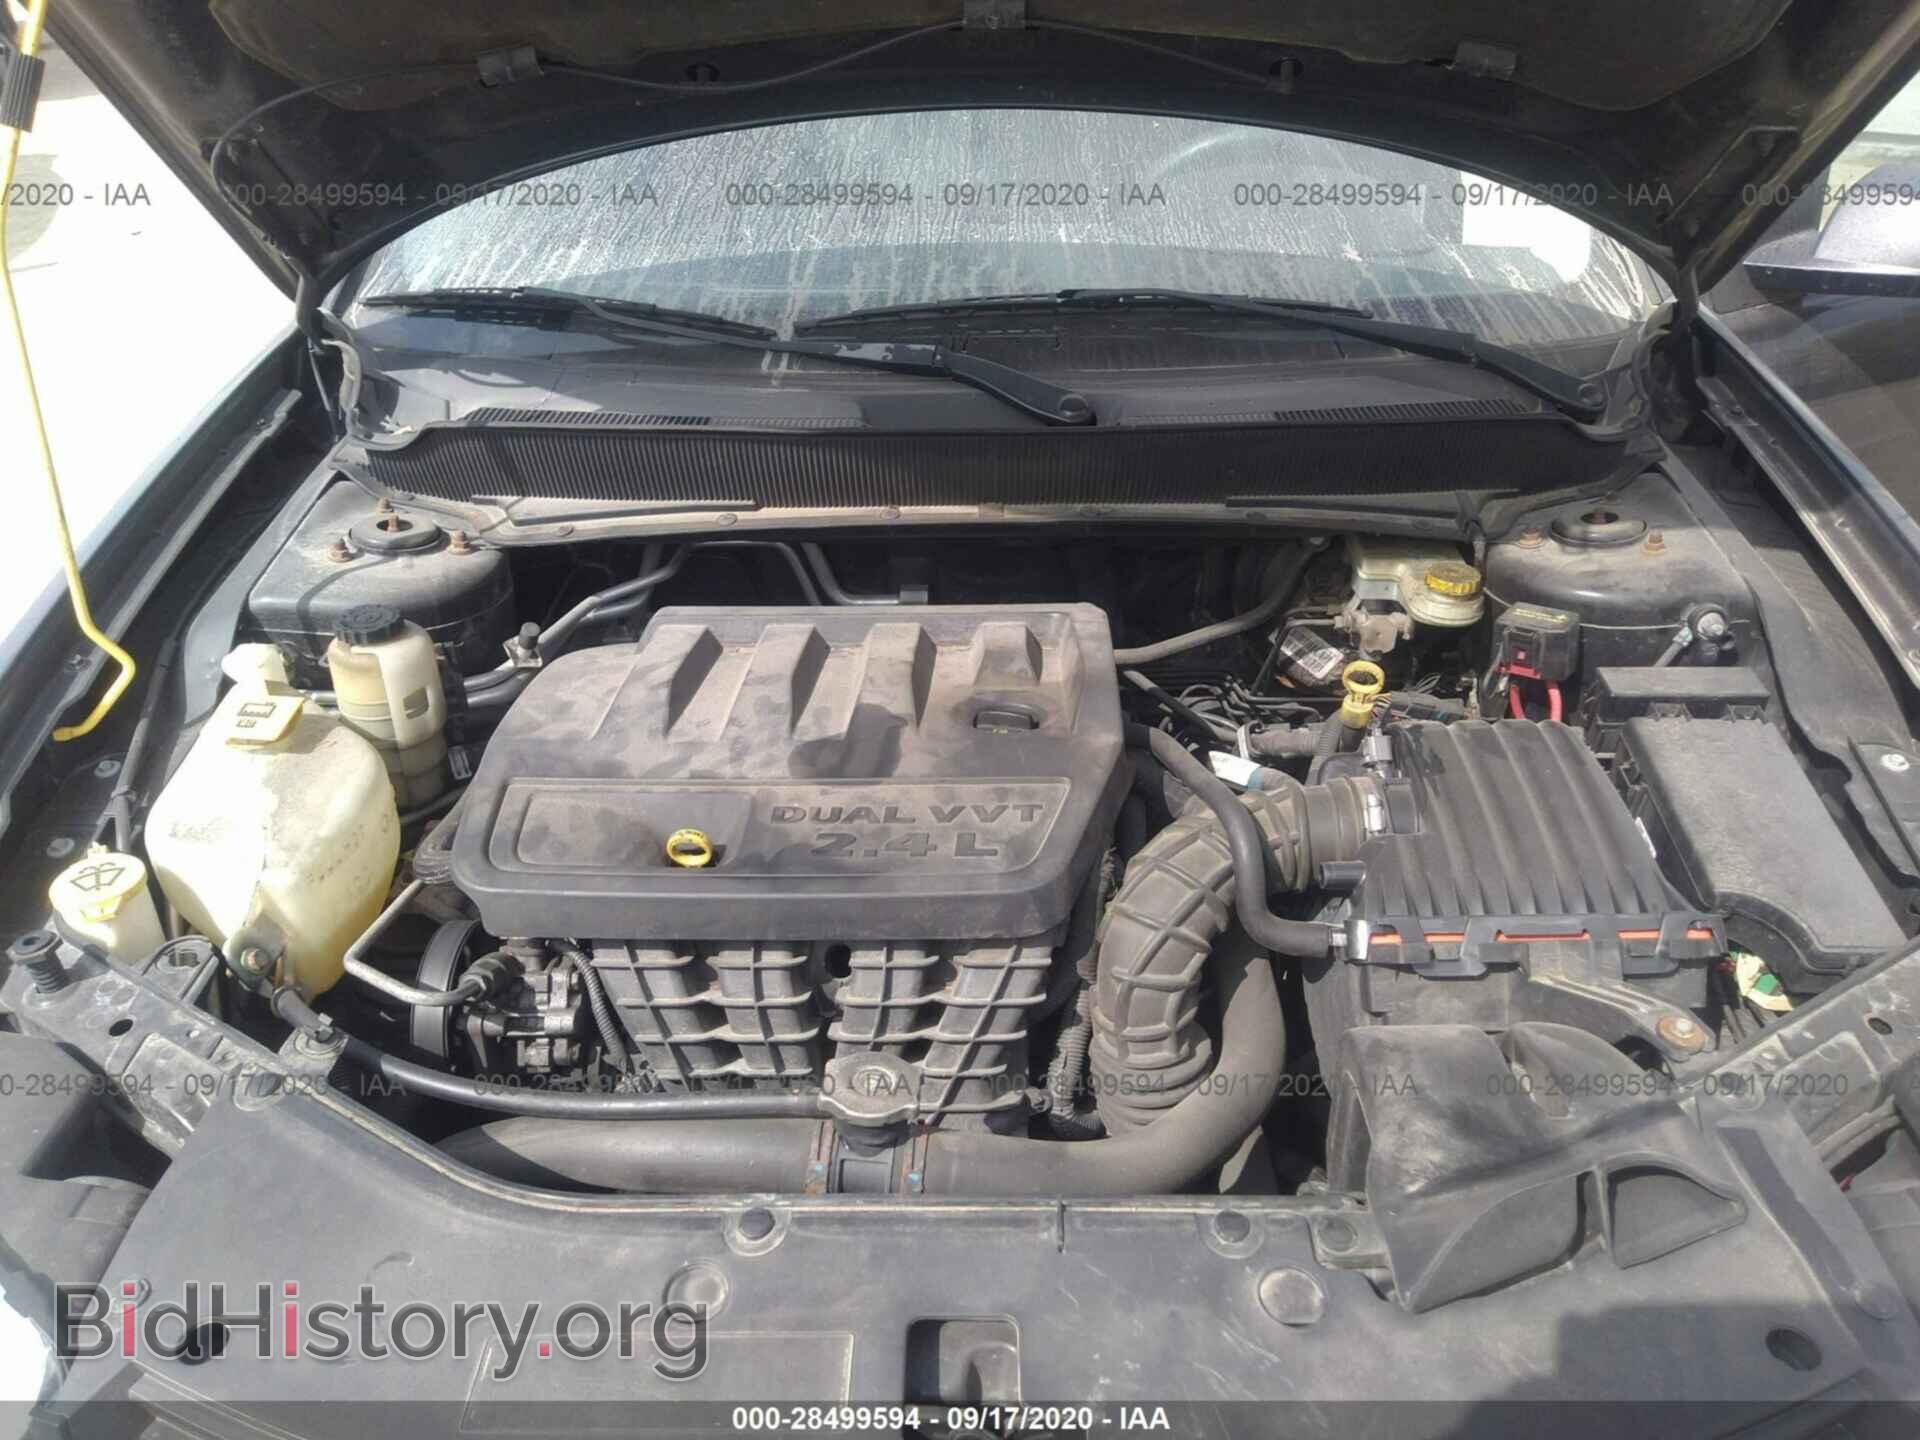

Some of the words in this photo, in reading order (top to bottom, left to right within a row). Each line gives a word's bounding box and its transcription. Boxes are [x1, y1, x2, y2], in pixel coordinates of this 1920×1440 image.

[770, 804, 916, 824] DUAL
[928, 803, 1044, 823] VVT
[811, 831, 938, 857] 2.4
[953, 831, 999, 857] L
